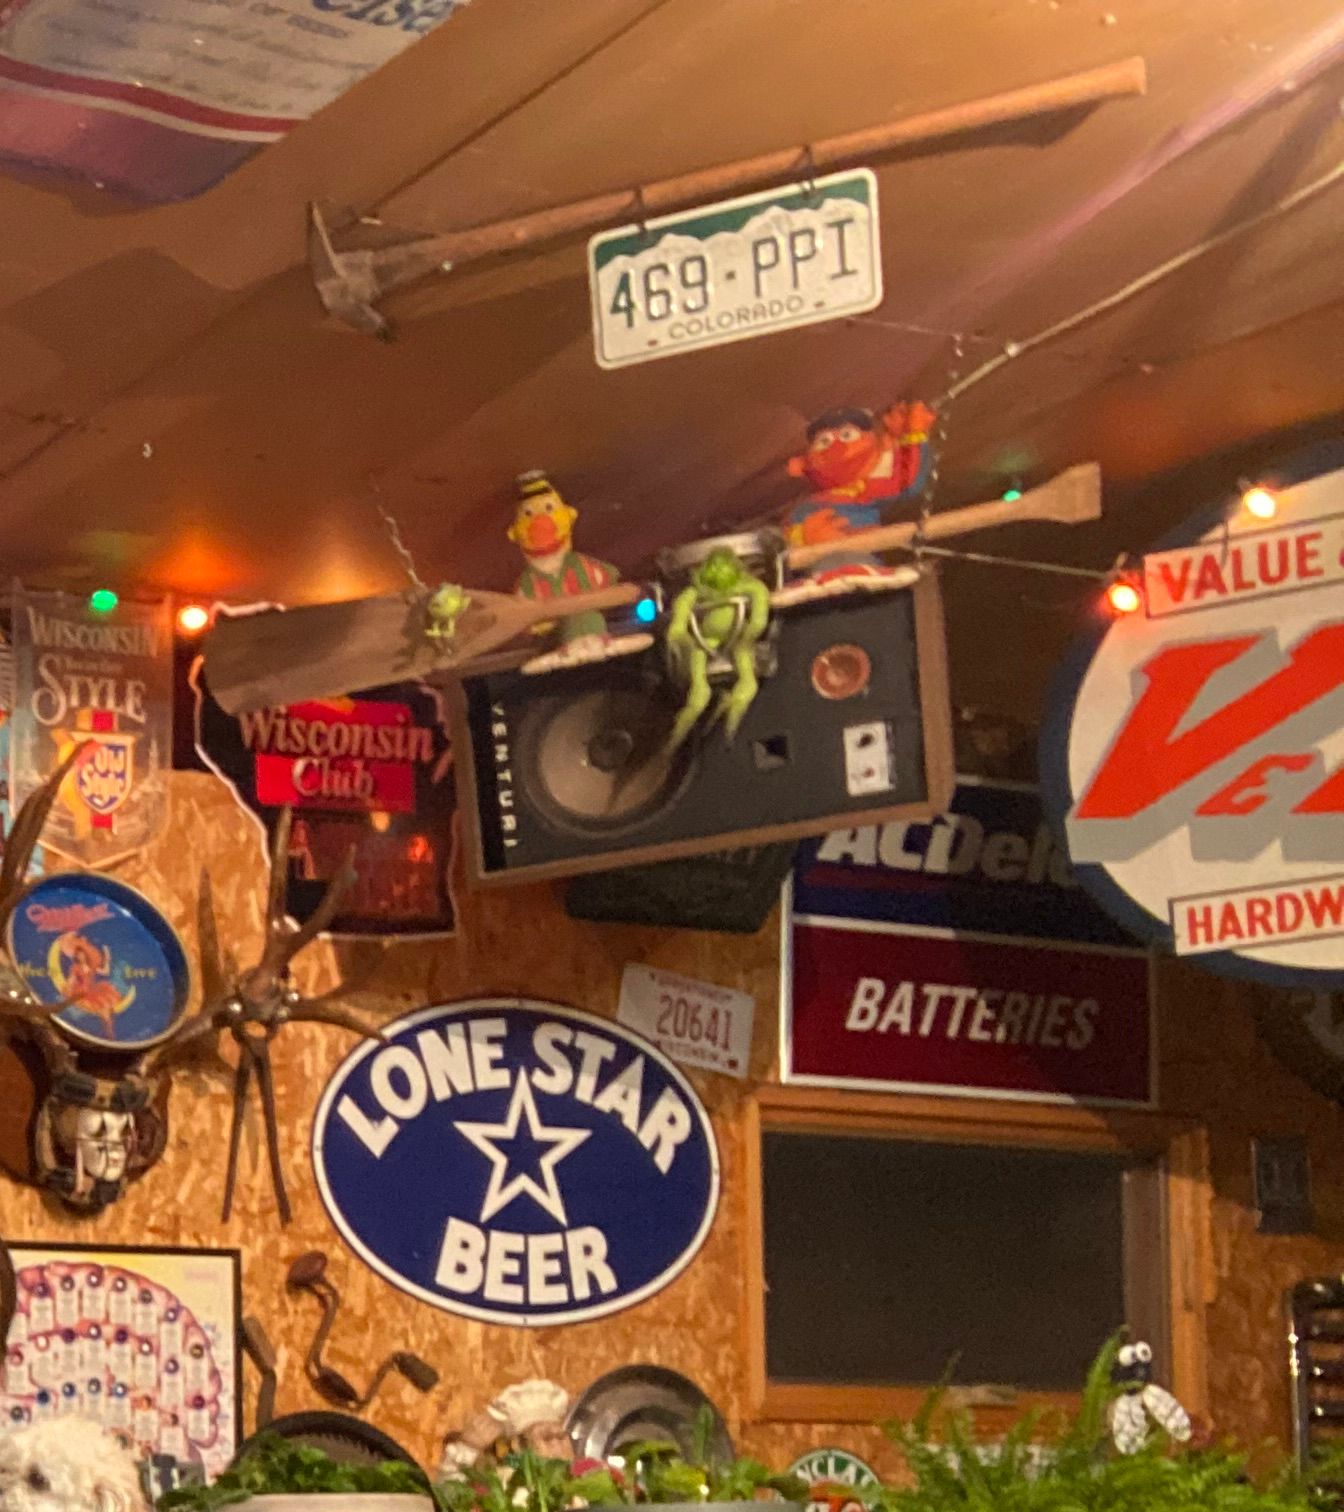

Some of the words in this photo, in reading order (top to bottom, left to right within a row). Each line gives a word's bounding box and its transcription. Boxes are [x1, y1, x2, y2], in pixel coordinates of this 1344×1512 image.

[668, 295, 805, 340] COLORADO
[1159, 530, 1325, 604] VALUE
[27, 605, 159, 659] WISCONSIN
[31, 653, 147, 726] STYLE
[240, 703, 435, 764] Wisconsin
[291, 755, 375, 799] Club
[655, 993, 732, 1052] 20641
[845, 976, 1100, 1050] BATTERIES
[337, 1017, 512, 1160] LONE
[530, 1022, 692, 1175] STAR
[434, 1216, 619, 1305] BEER
